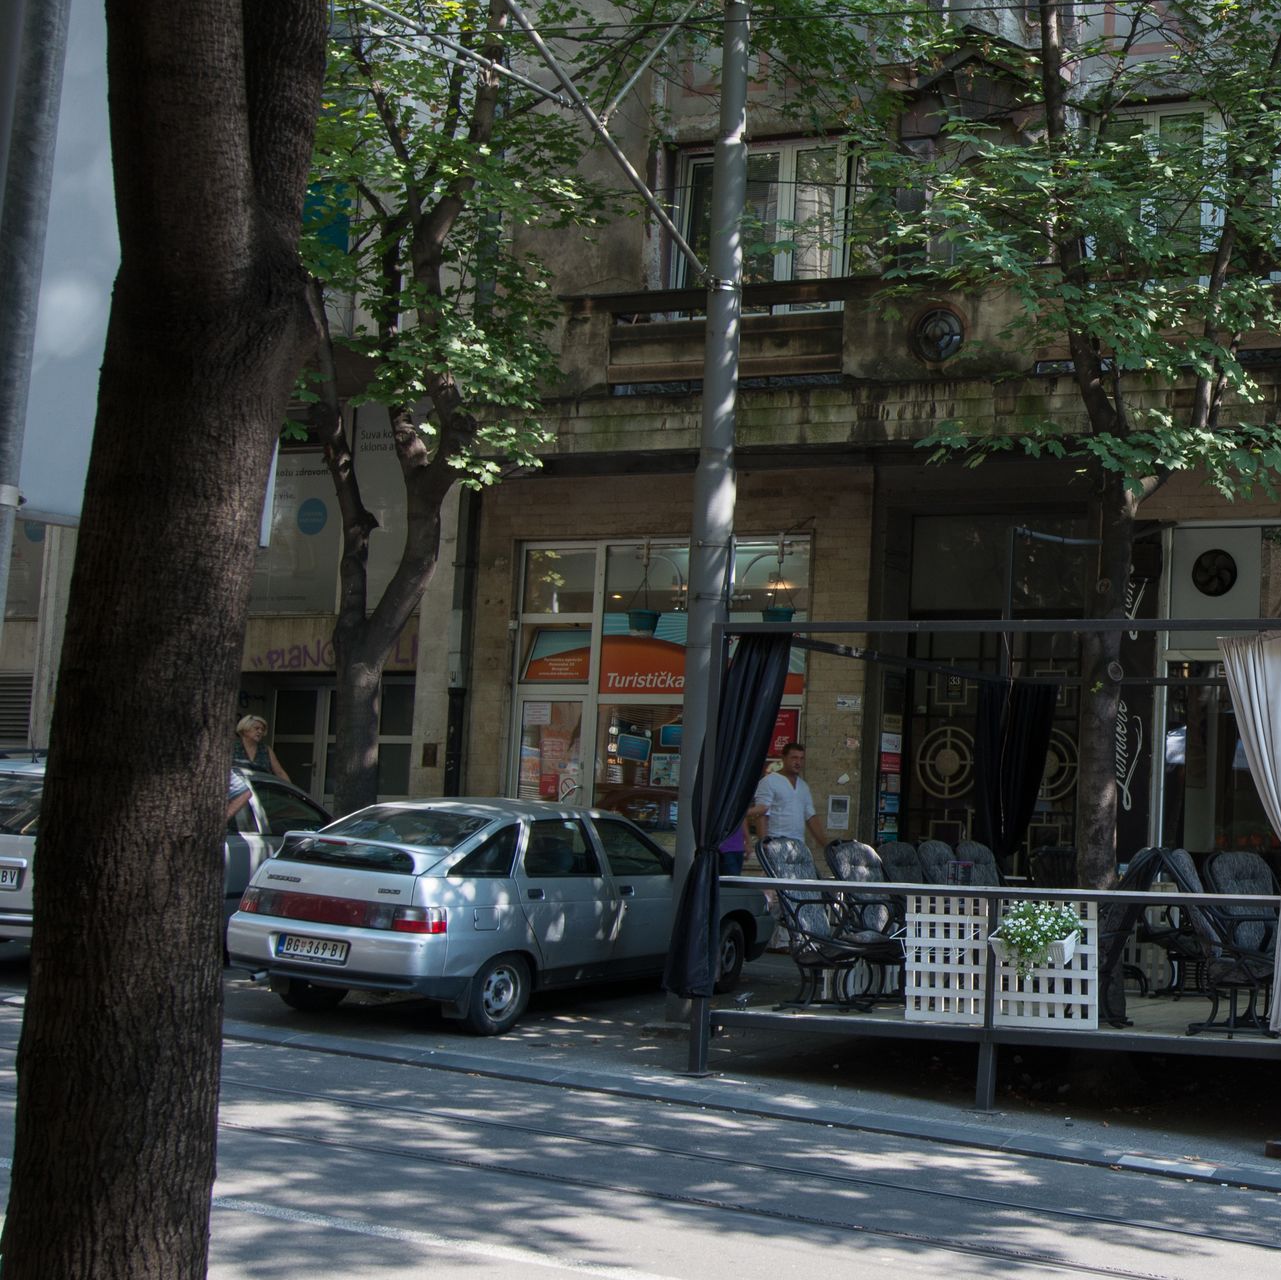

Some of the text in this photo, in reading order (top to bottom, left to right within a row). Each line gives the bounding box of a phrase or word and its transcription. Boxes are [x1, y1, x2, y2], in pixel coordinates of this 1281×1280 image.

[607, 671, 685, 689] Turistička
[949, 676, 961, 685] 33
[1, 870, 17, 884] BV
[285, 937, 300, 952] BG
